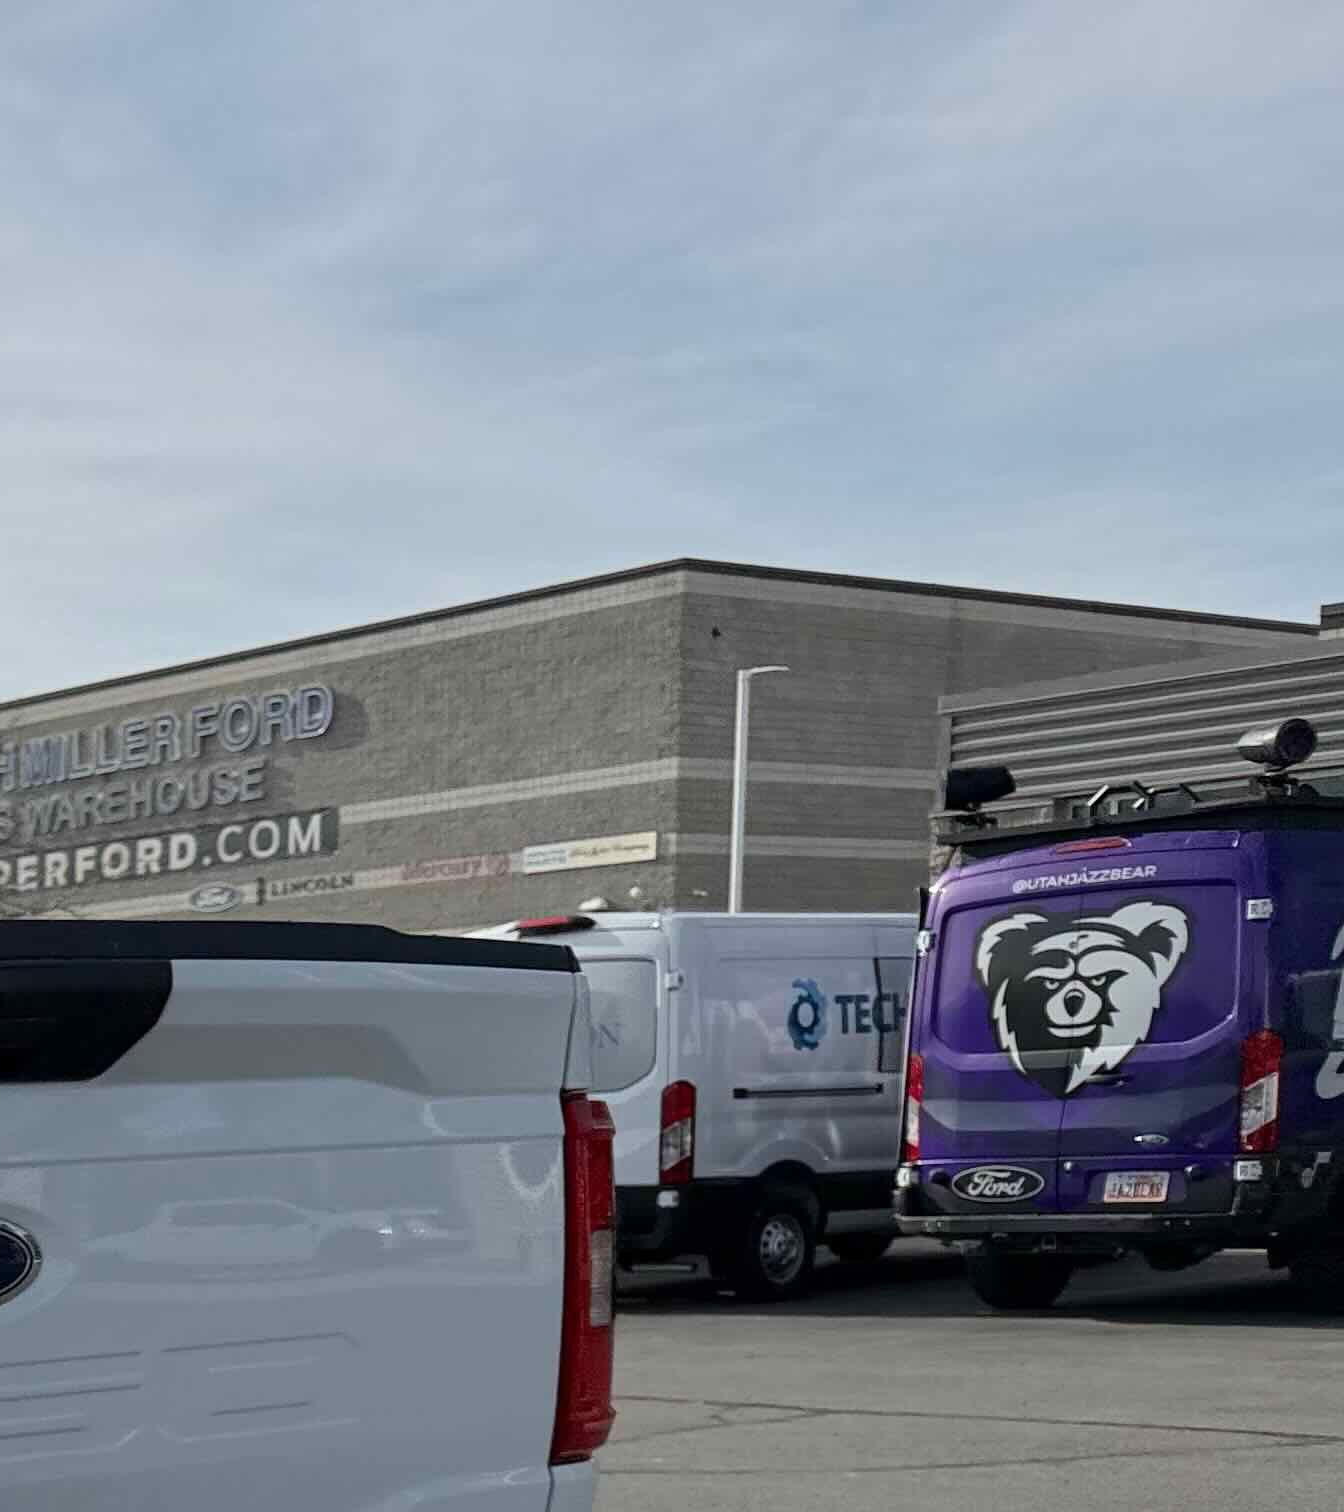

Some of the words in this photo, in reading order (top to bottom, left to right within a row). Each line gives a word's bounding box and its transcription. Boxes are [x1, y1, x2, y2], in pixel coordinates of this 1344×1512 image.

[18, 714, 182, 788] MILLER
[191, 683, 335, 759] FORD
[29, 757, 266, 837] WAREHOUSE
[271, 874, 355, 898] LINCOLN
[1013, 865, 1158, 894] @UTAHJAZZBEAR
[967, 1169, 1025, 1197] Ford
